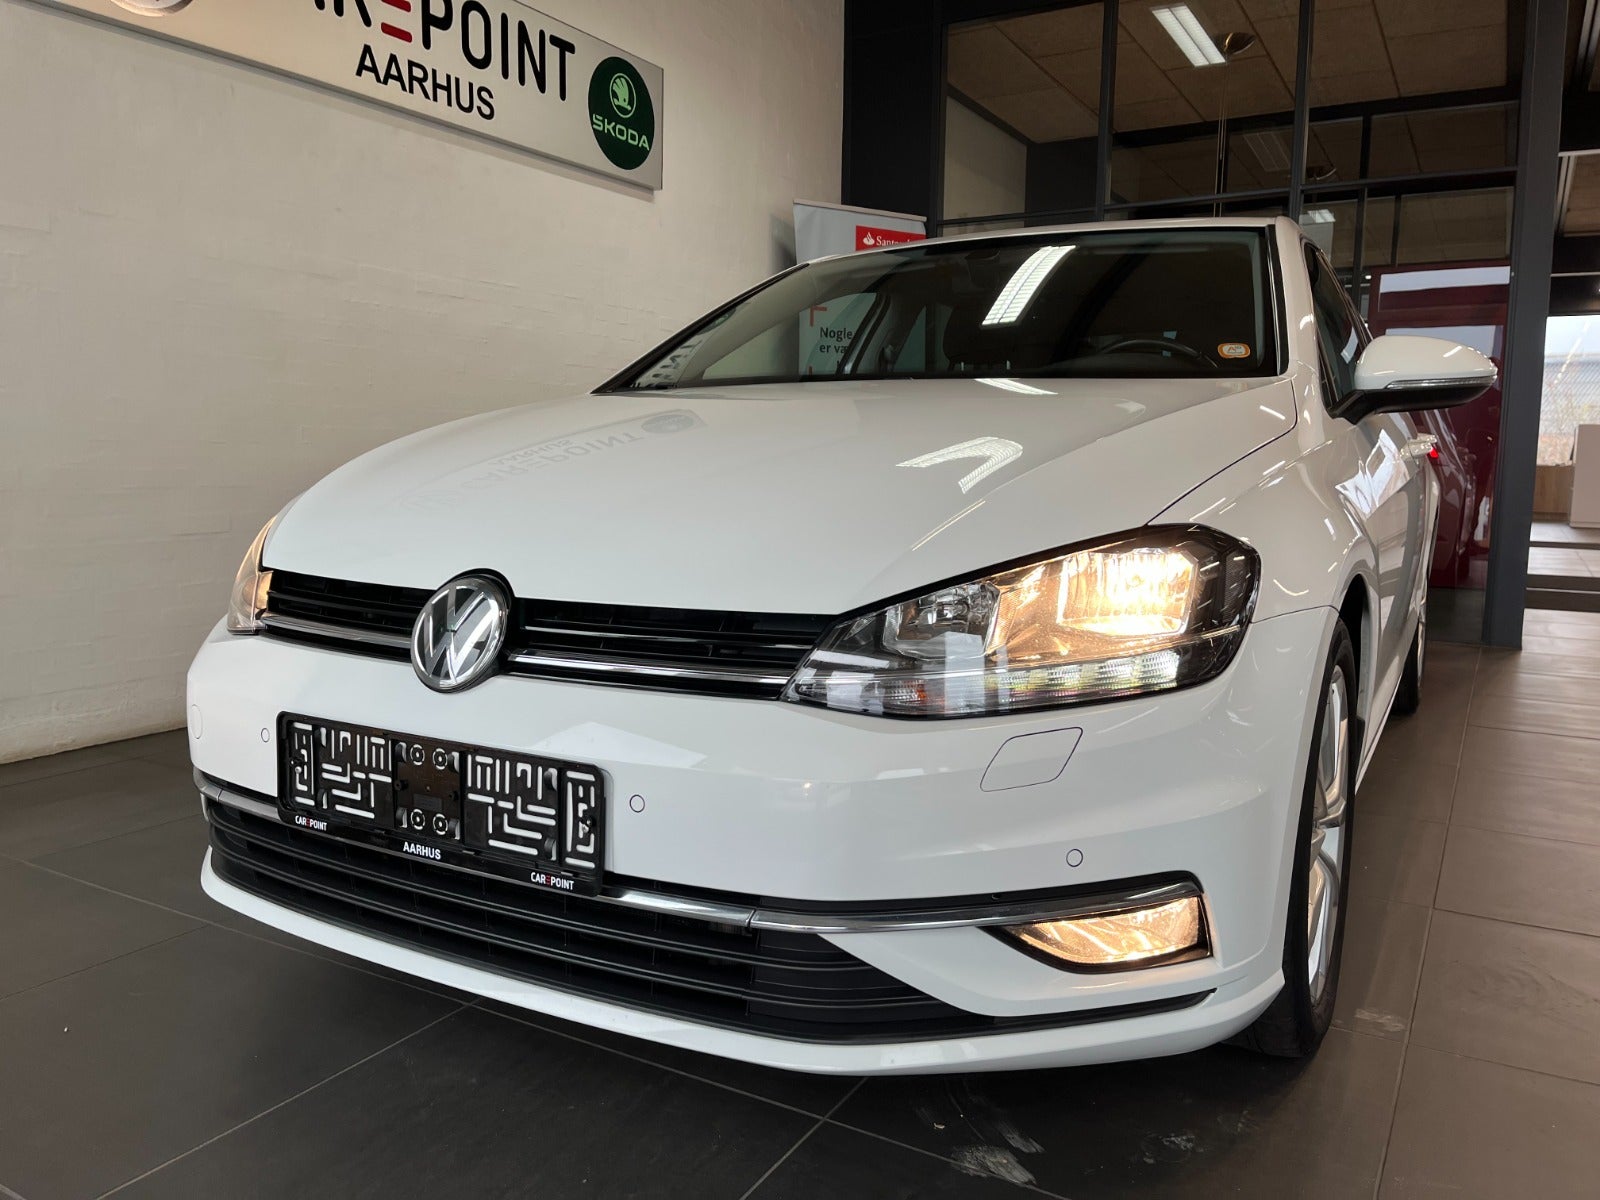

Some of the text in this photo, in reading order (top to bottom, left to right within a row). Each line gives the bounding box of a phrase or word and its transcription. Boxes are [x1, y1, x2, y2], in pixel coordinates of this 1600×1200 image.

[355, 43, 495, 120] AARHUS
[819, 344, 831, 353] er
[402, 841, 442, 860] AARHUS
